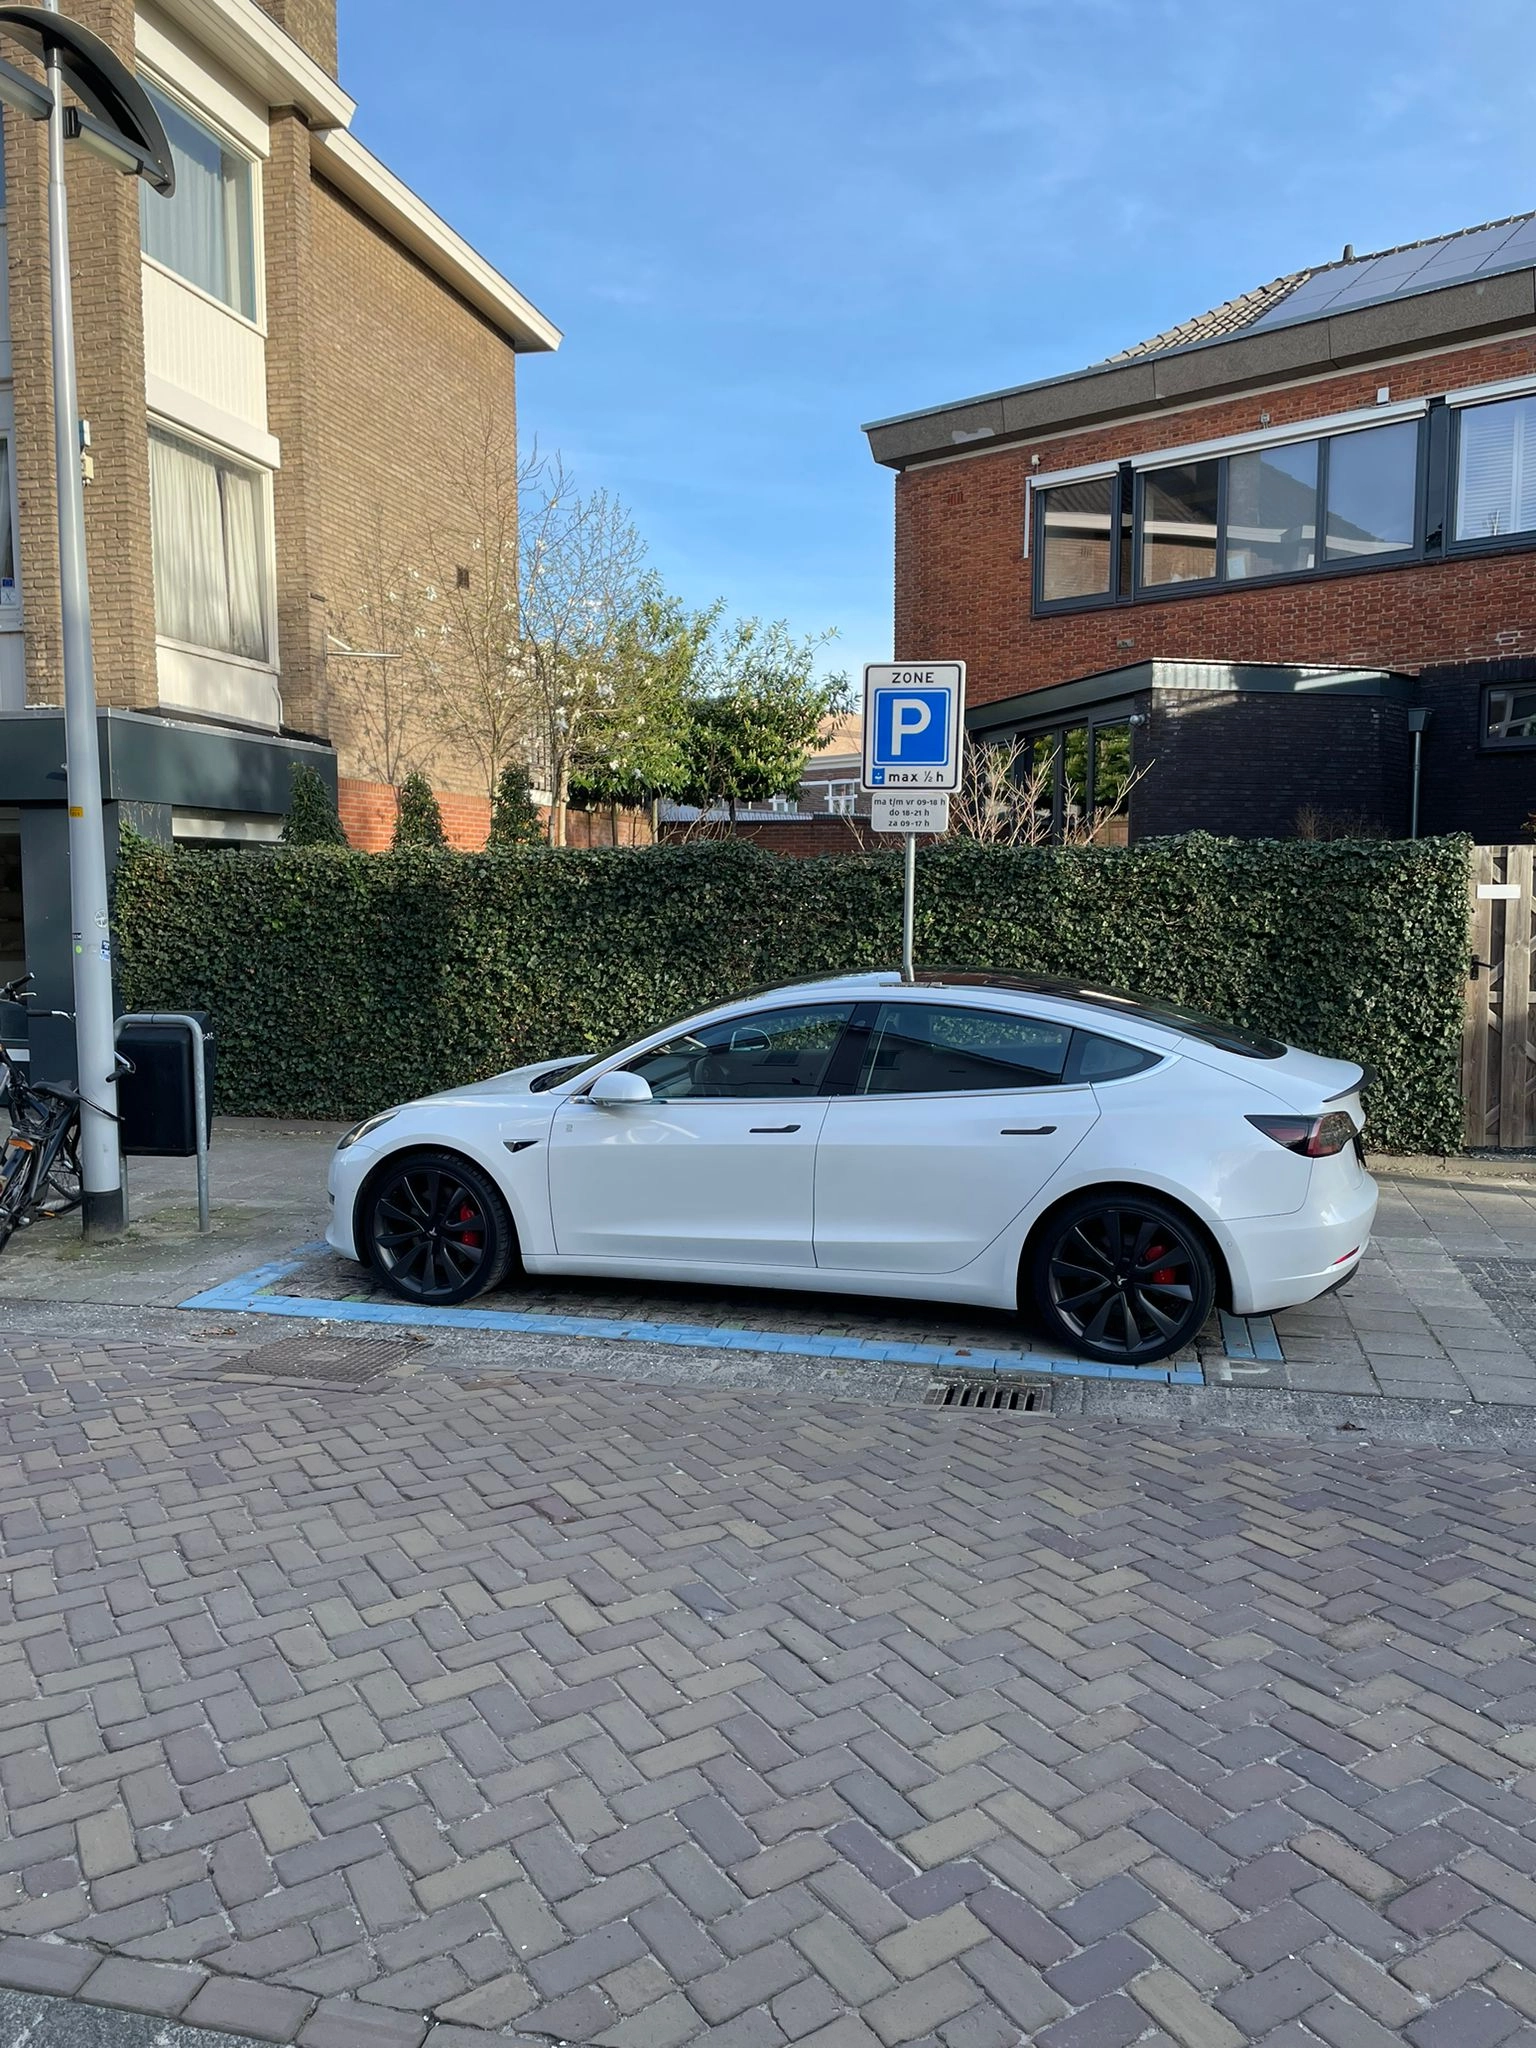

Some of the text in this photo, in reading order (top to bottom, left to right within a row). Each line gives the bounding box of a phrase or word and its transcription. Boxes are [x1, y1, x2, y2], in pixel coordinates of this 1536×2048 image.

[892, 672, 934, 683] ZONE
[891, 698, 932, 756] P
[888, 773, 918, 782] max
[936, 771, 944, 782] h
[889, 798, 903, 807] t/m
[889, 808, 900, 816] do
